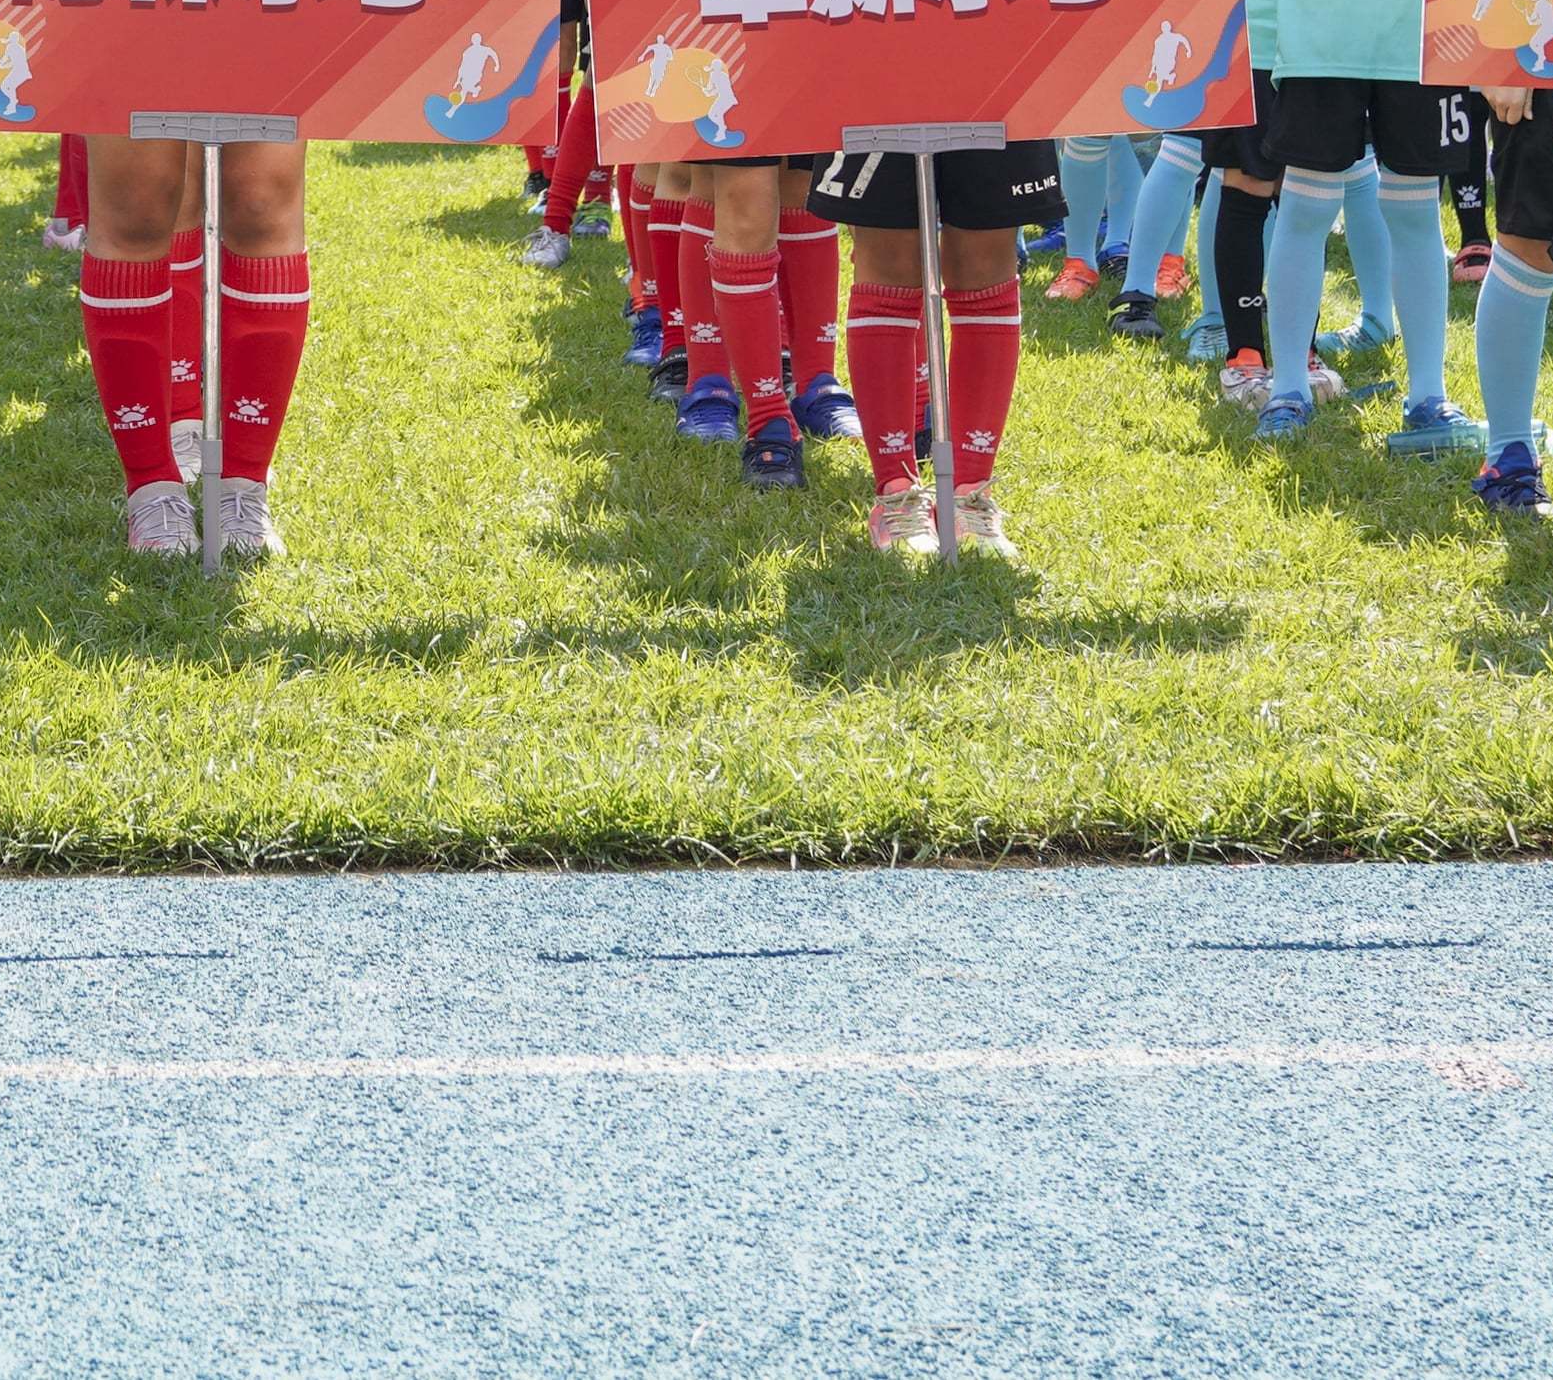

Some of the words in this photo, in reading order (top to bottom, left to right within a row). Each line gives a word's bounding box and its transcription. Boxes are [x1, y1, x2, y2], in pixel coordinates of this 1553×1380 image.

[1438, 93, 1470, 147] 15
[1011, 174, 1059, 197] KELME
[113, 416, 157, 430] KELME
[229, 411, 270, 425] KELME
